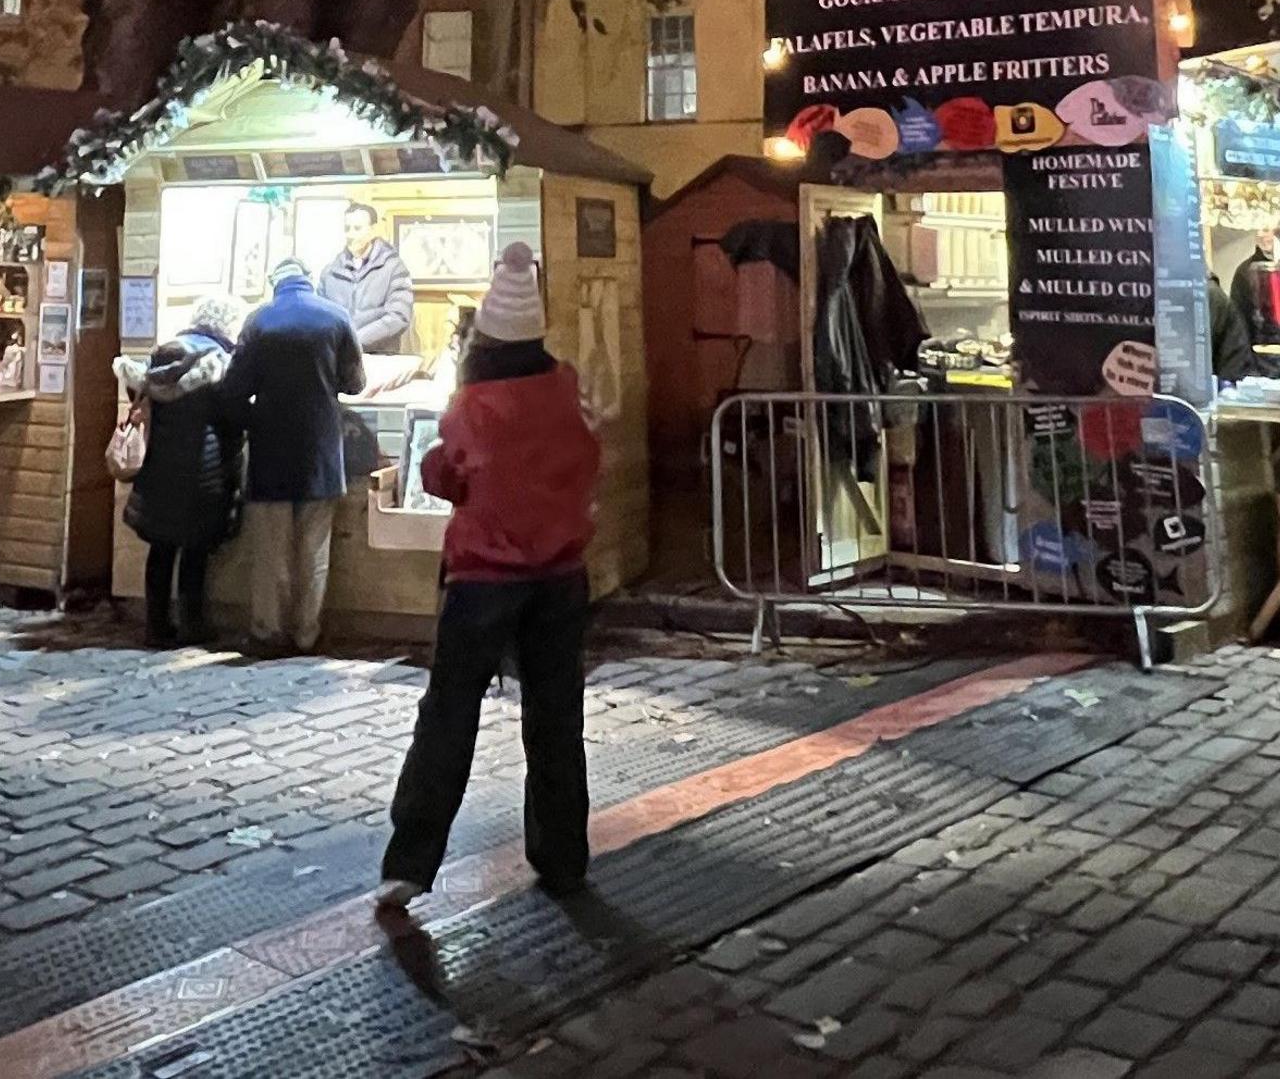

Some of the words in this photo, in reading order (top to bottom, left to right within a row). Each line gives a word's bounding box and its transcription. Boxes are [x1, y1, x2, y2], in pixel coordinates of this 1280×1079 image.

[881, 14, 1015, 44] VEGETABLE
[1019, 5, 1150, 34] TEMPURA,
[804, 70, 887, 94] BANANA
[892, 68, 909, 87] &
[915, 61, 988, 86] APPLE
[993, 53, 1109, 81] FRITTERS
[1032, 153, 1142, 170] HOMEMADE
[1048, 173, 1124, 190] FESTIVE
[1029, 217, 1104, 233] MULLED
[1037, 249, 1113, 266] MULLED
[1117, 250, 1152, 266] GIN
[1019, 278, 1033, 294] &
[1037, 279, 1113, 297] MULLED
[1117, 281, 1152, 298] CID
[1106, 312, 1154, 327] AVAILA
